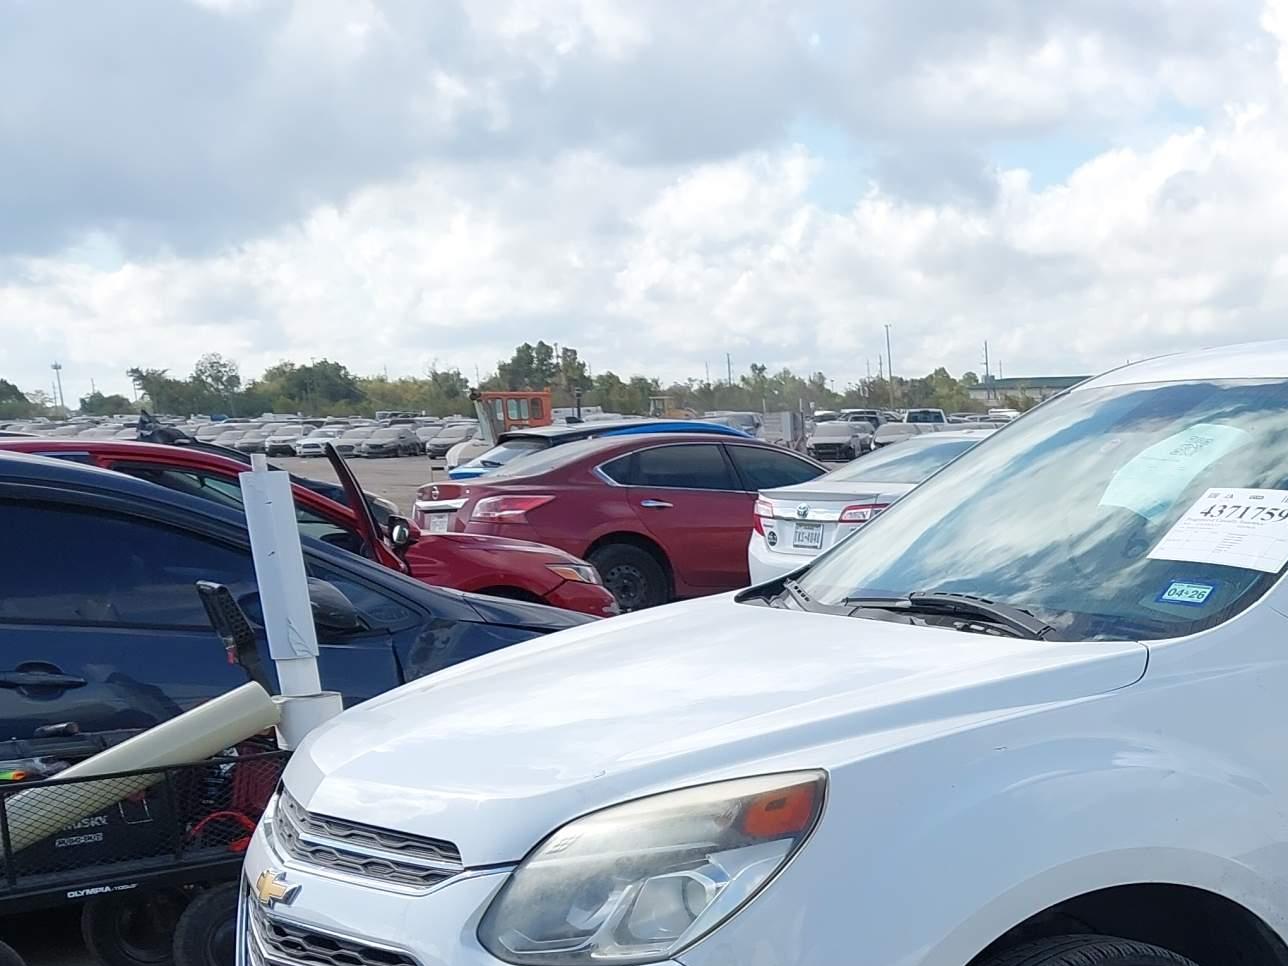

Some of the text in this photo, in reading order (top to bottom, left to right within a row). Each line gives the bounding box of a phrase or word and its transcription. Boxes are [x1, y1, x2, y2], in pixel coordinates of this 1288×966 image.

[1167, 588, 1207, 600] 04 26
[66, 885, 112, 899] OLYMPIA
